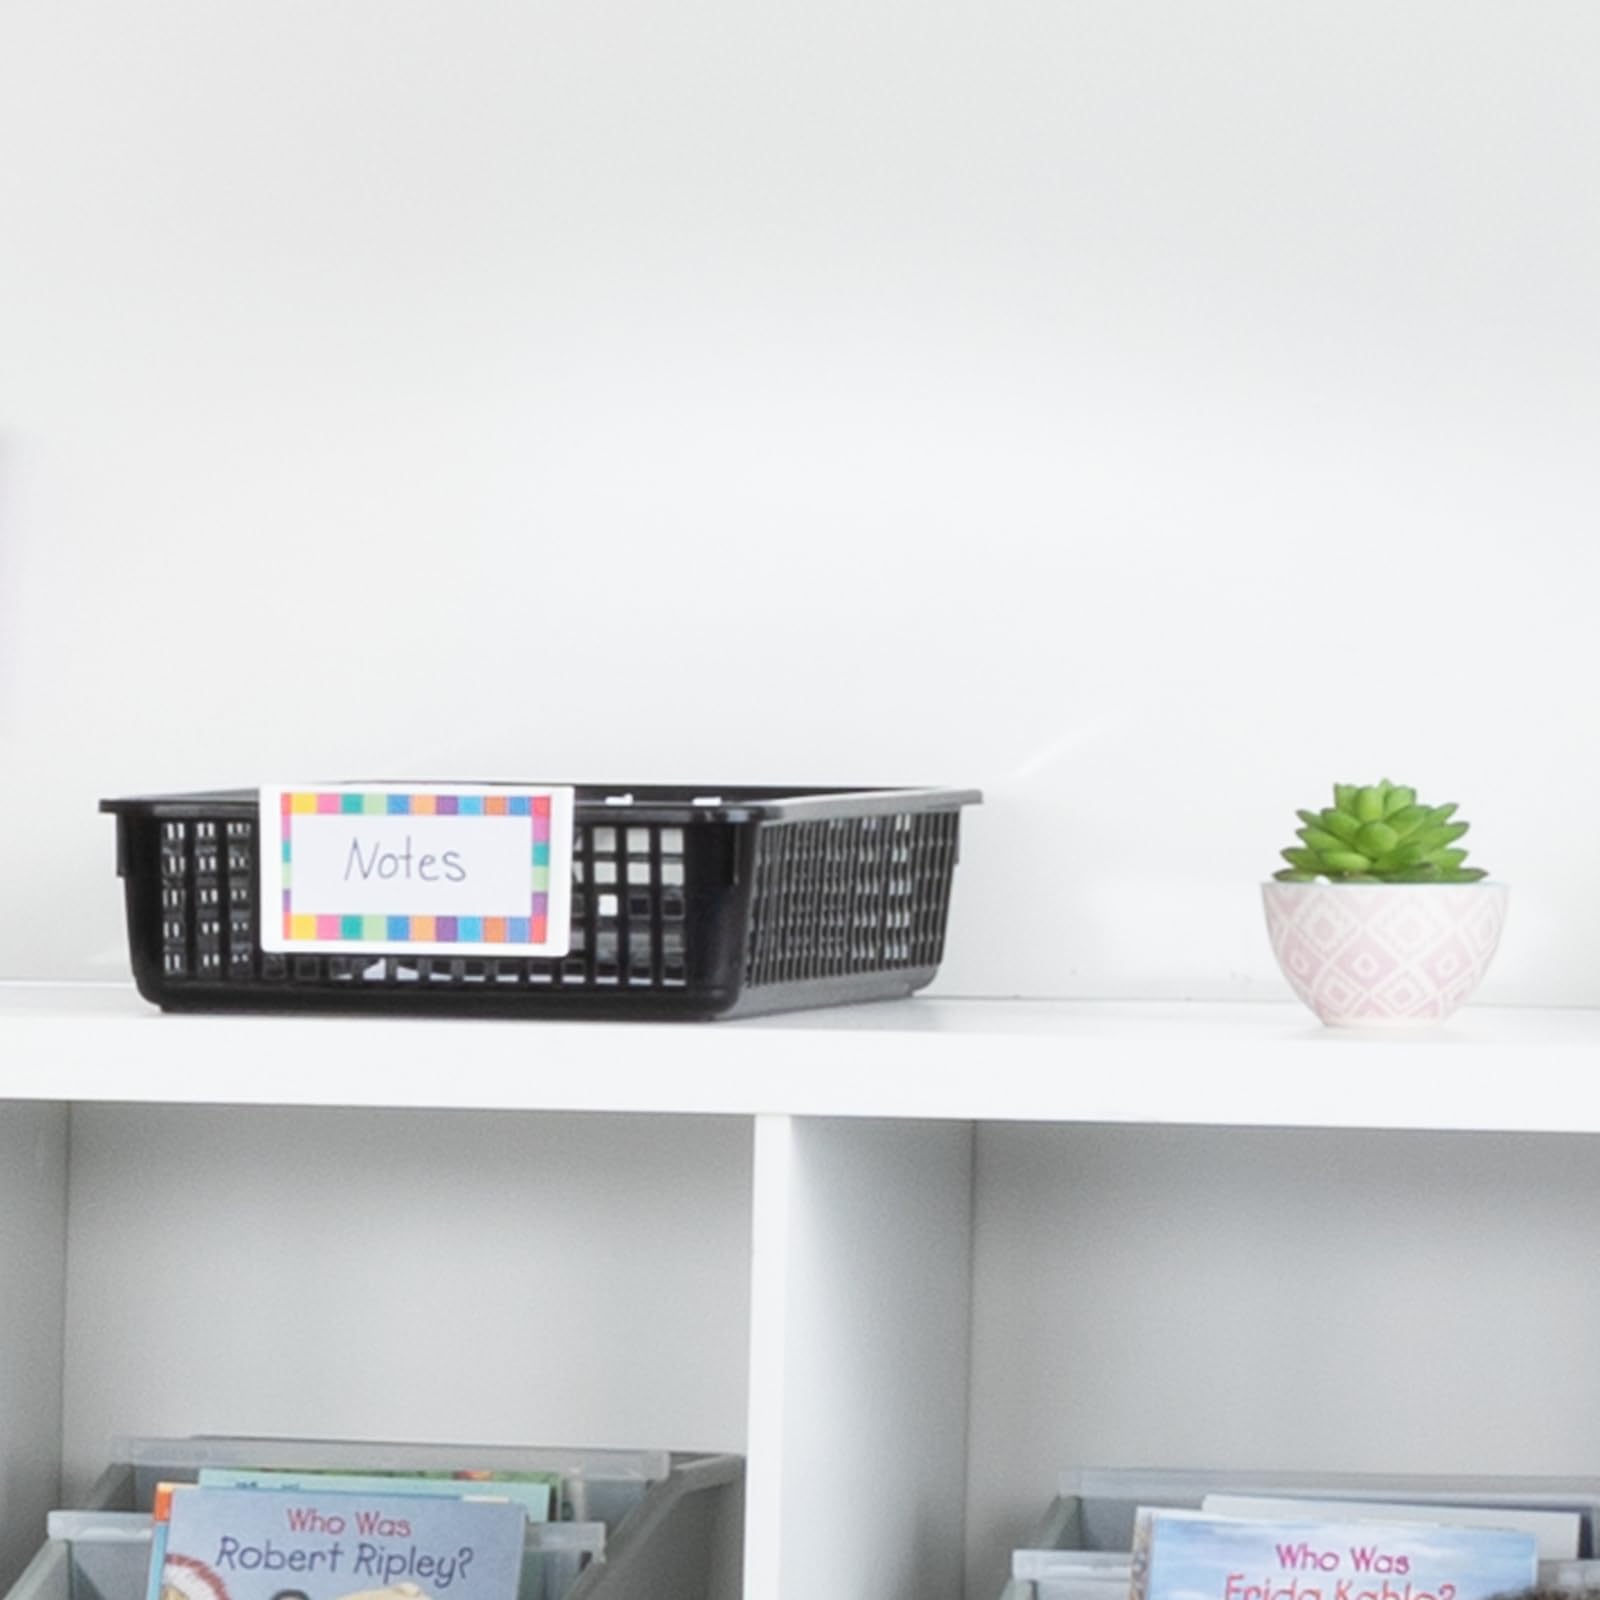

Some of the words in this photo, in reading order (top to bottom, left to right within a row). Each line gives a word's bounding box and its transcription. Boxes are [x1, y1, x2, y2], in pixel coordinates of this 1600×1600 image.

[344, 835, 467, 882] Notes
[287, 1508, 346, 1535] Who
[355, 1511, 411, 1538] Was
[214, 1536, 344, 1574] Robert
[353, 1542, 474, 1588] Ripley?
[1275, 1543, 1340, 1572] Who
[1349, 1546, 1411, 1576] Was
